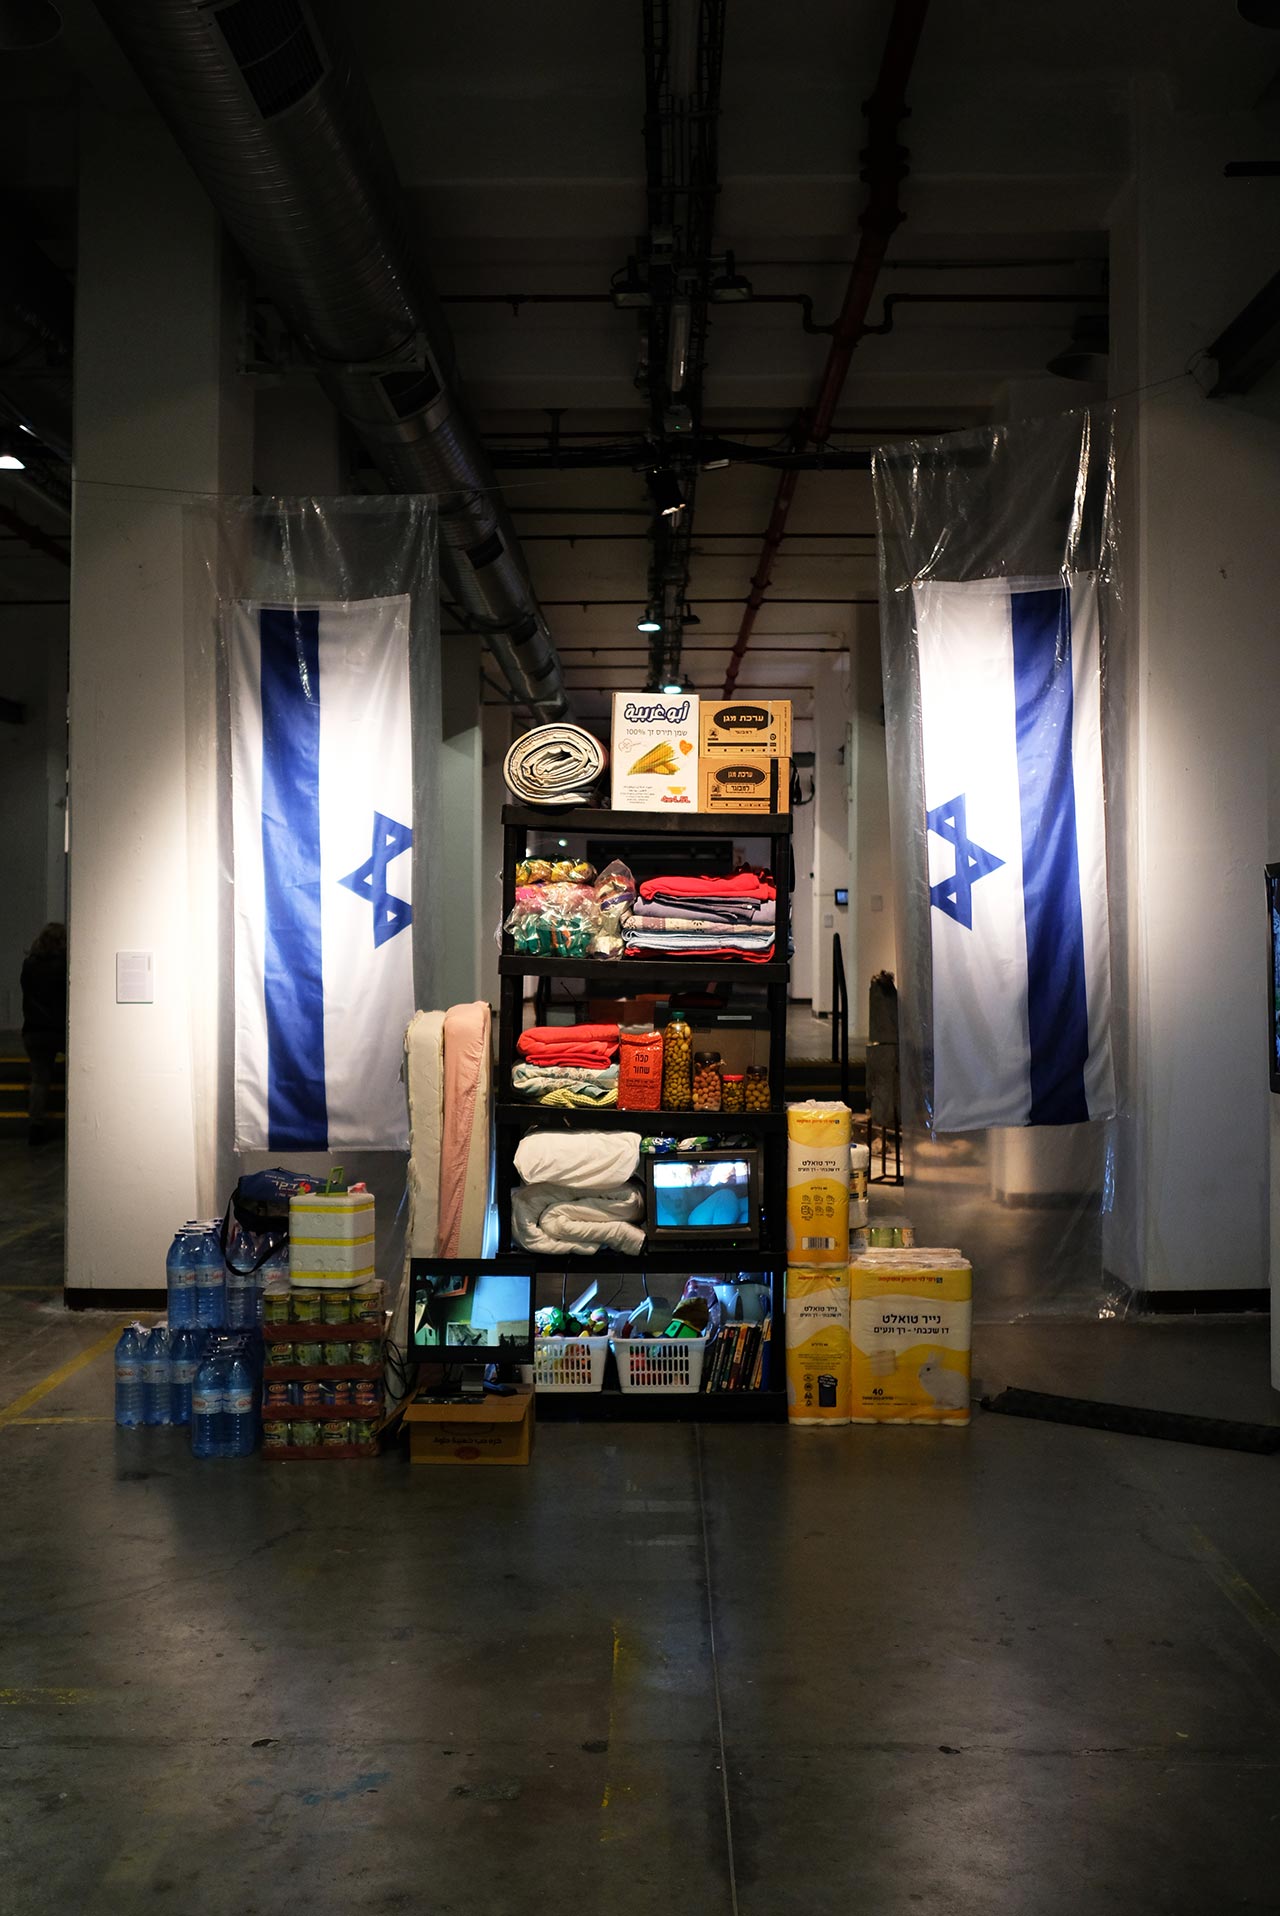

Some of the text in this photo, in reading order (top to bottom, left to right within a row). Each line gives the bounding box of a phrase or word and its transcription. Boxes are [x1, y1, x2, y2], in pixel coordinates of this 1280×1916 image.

[624, 700, 690, 724] أبو غربية
[723, 715, 737, 723] מגן
[674, 729, 688, 737] שמן
[635, 1054, 648, 1063] קפה
[633, 1066, 650, 1075] שחור
[882, 1314, 941, 1324] נייר טואלט
[897, 1327, 906, 1335] רך
[872, 1388, 883, 1396] 40
